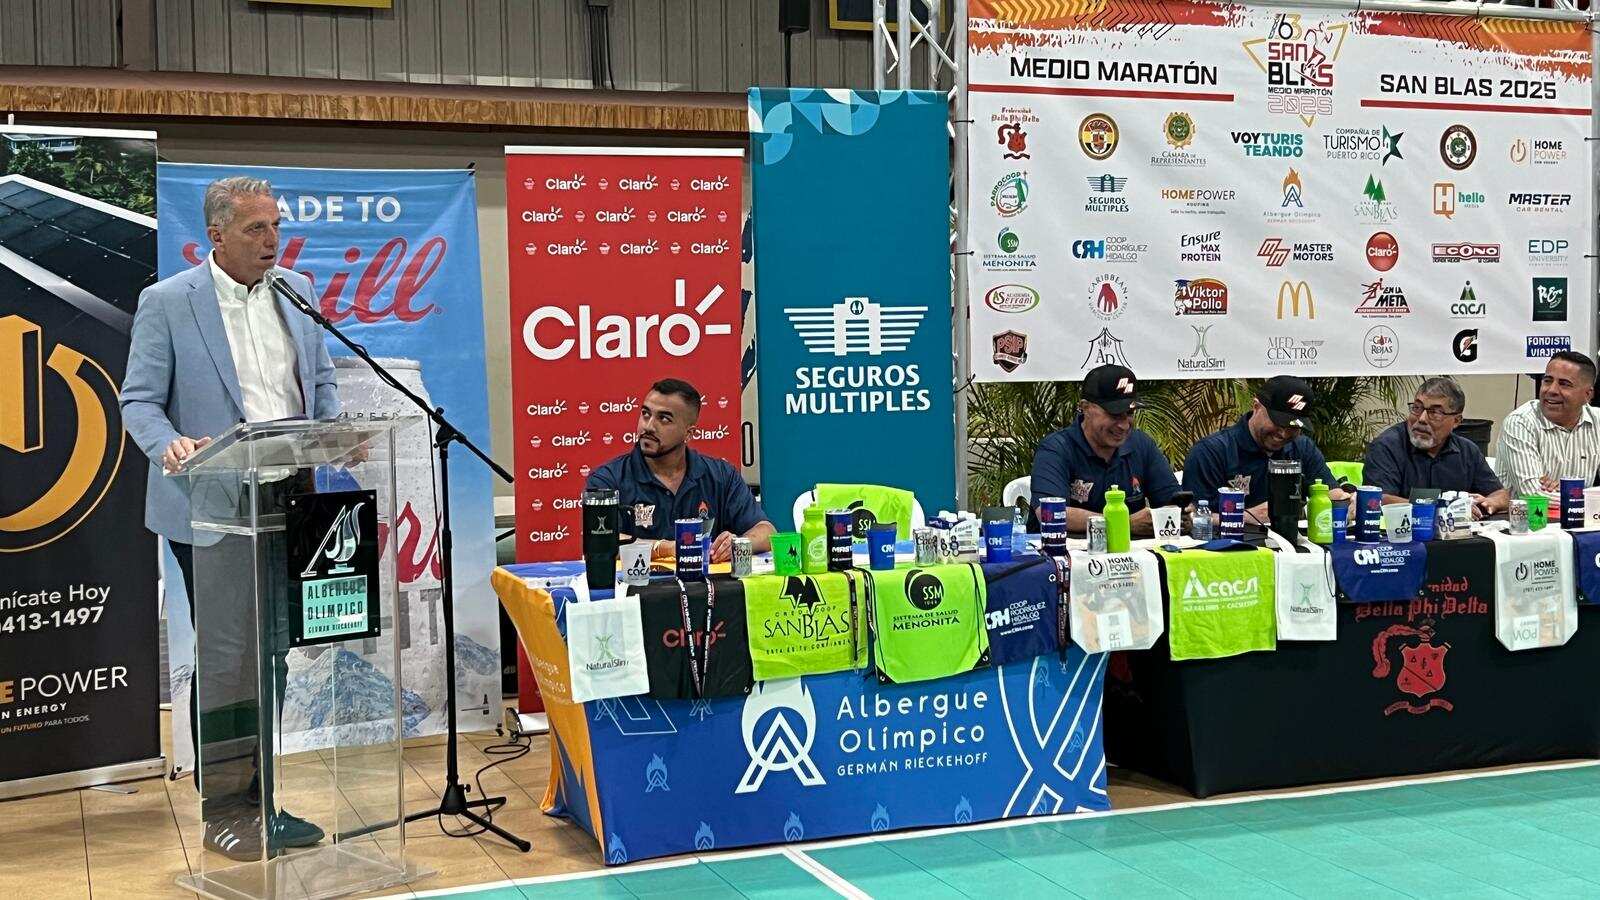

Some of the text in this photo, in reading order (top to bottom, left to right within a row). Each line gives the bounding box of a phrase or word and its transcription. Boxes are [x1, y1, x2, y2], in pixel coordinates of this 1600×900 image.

[1268, 42, 1307, 61] SAN
[1010, 57, 1217, 85] MEDIO MARATÓN
[1268, 62, 1333, 87] BLAS
[1380, 74, 1556, 99] SAN BLAS 2025
[1268, 95, 1332, 115] 2025
[1323, 135, 1380, 150] TURISMO
[1534, 141, 1562, 150] HOME
[1243, 145, 1303, 157] TEANDO
[1327, 150, 1380, 159] PUERTO RICO
[1534, 150, 1567, 160] POWER
[1150, 157, 1207, 165] REPRESENTANTES
[546, 174, 729, 191] Claro Claro Claro
[1089, 196, 1126, 205] SEGUROS
[1458, 192, 1485, 204] hello
[1509, 193, 1571, 206] MASTER
[277, 195, 402, 224] ADE TO
[522, 206, 706, 222] Claro Claro Claro
[1085, 204, 1130, 213] MULTIPLES
[1106, 236, 1127, 244] COOP
[1181, 230, 1221, 248] Ensure
[547, 239, 730, 254] Claro Claro Claro
[1200, 244, 1221, 253] MAX
[1293, 243, 1333, 252] MASTER
[1367, 244, 1396, 257] Claro
[1434, 245, 1498, 257] ECONO
[1528, 239, 1568, 253] EDP
[1106, 252, 1138, 260] HIDALGO
[1181, 252, 1221, 262] PROTEIN
[1292, 252, 1334, 261] MOTORS
[1528, 254, 1568, 262] UNIVERSITY
[1187, 286, 1225, 298] Viktor
[1193, 298, 1222, 309] Pollo
[1375, 295, 1408, 307] META
[523, 286, 726, 360] Claro
[1267, 336, 1294, 349] MED
[1528, 336, 1570, 347] FONDISTA
[1267, 347, 1318, 360] CENTRO
[1177, 358, 1226, 370] NaturalSlim
[796, 364, 920, 389] SEGUROS
[527, 397, 639, 416] Claro Claro
[785, 389, 931, 415] MULTIPLES
[552, 430, 591, 447] Claro
[528, 462, 569, 479] Claro
[529, 525, 570, 542] Claro
[679, 555, 704, 563] MAST
[1107, 556, 1134, 564] HOME
[1534, 560, 1556, 568] HOME
[1108, 563, 1139, 572] POWER
[1535, 567, 1560, 576] POWER
[69, 584, 111, 605] Hoy
[308, 579, 366, 600] ALBERGUE
[922, 585, 944, 600] SSM
[1010, 600, 1028, 610] COOP
[0, 606, 104, 633] 413-1497
[893, 617, 960, 631] MENONITA
[586, 658, 630, 672] NaturalSlim
[20, 666, 128, 701] POWER
[16, 702, 67, 718] ENERGY
[836, 690, 989, 720] Albergue
[13, 715, 90, 732] FUTURO PARA TODOS
[838, 723, 986, 756] Olímpico
[904, 752, 988, 771] RIECKEHOFF
